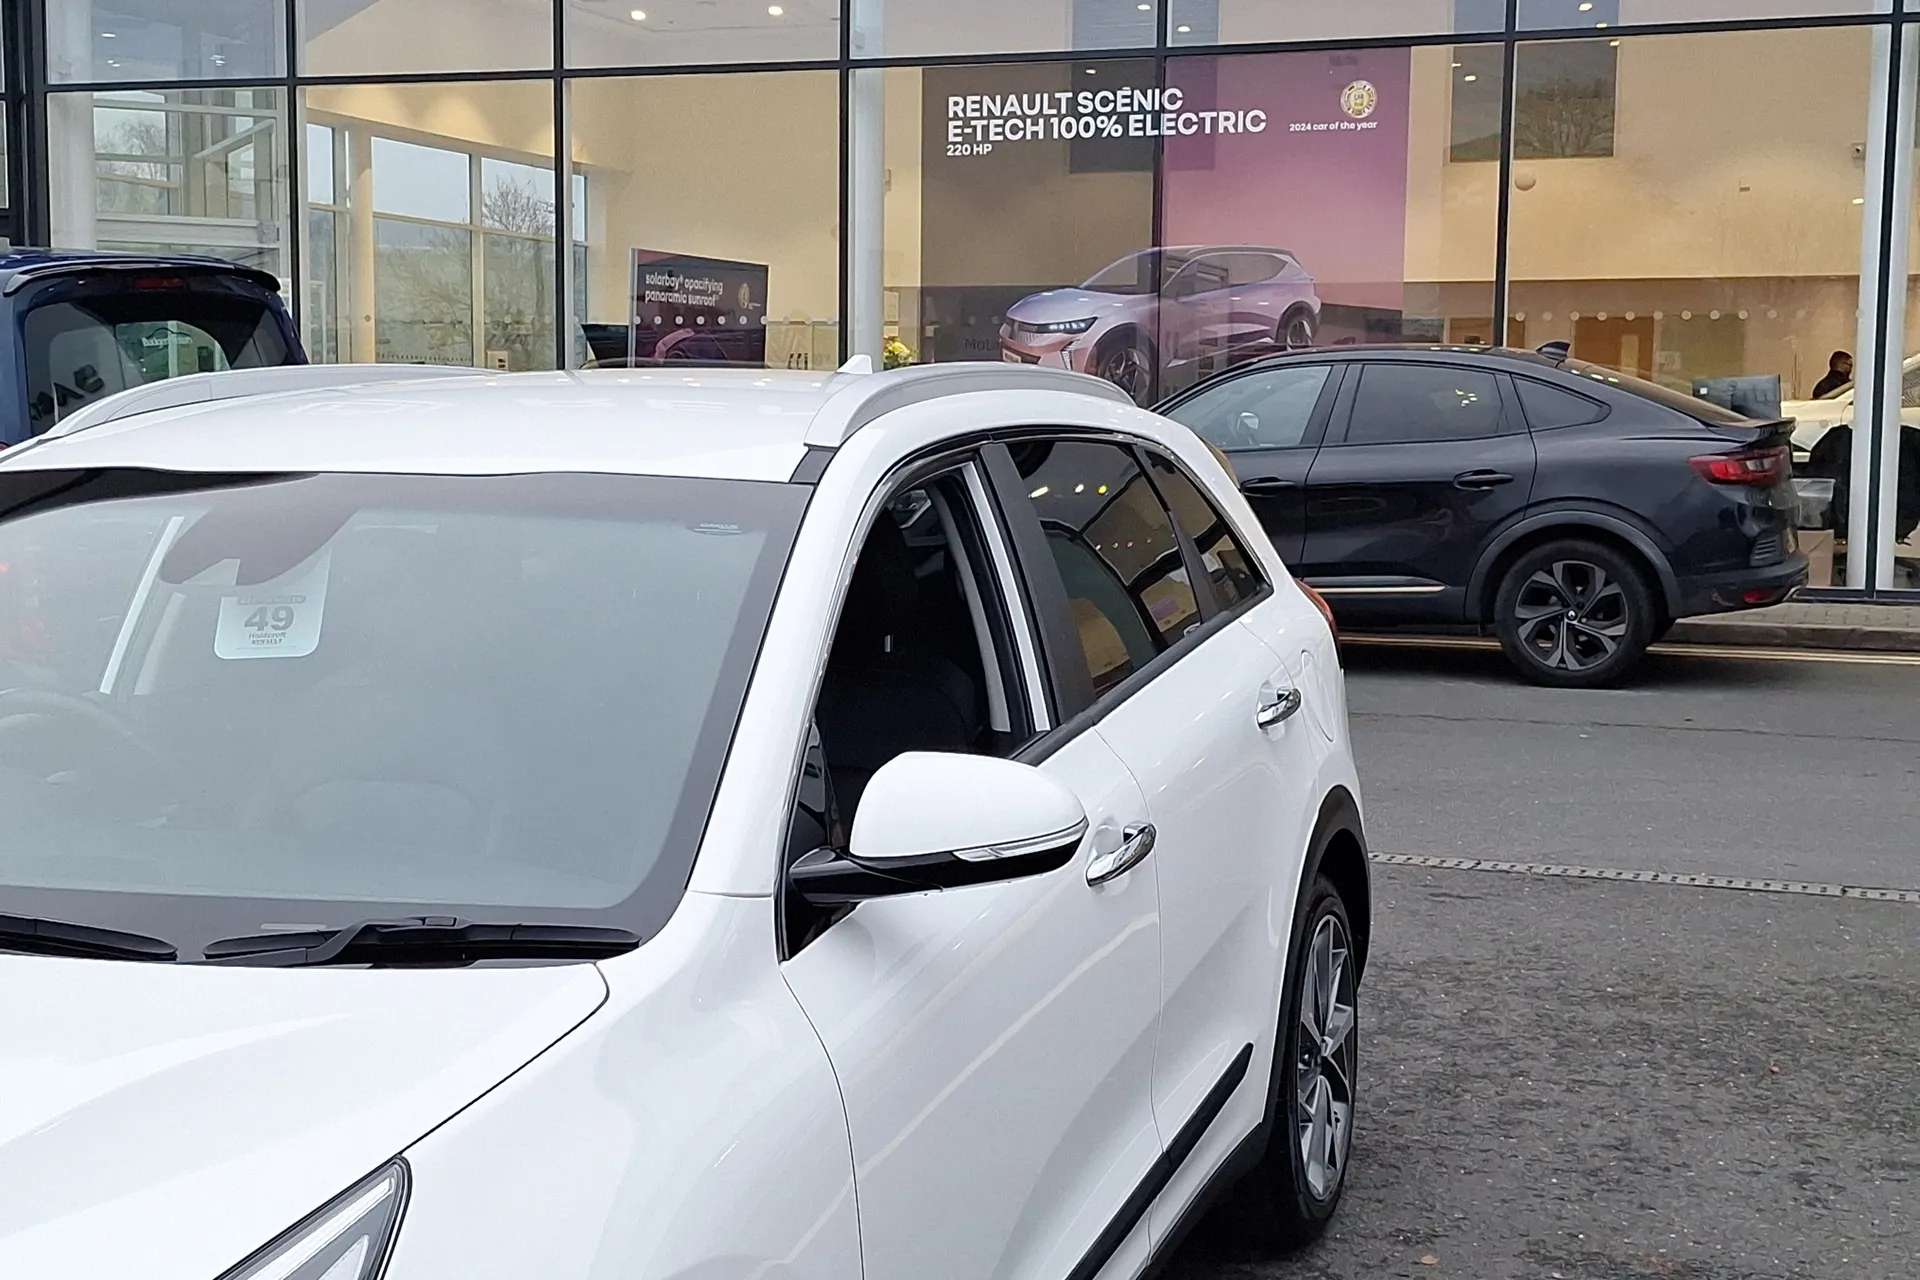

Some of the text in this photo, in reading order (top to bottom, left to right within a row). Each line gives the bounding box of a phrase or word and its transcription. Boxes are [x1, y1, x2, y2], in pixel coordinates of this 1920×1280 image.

[947, 91, 1073, 118] RENAULT
[947, 109, 1268, 143] E-TECH 100% ELECTRIC
[1289, 121, 1378, 132] 2024 car of the year
[946, 143, 993, 156] 220 HP
[684, 276, 724, 295] opacifying
[644, 289, 688, 304] panoramic
[243, 605, 295, 632] 49
